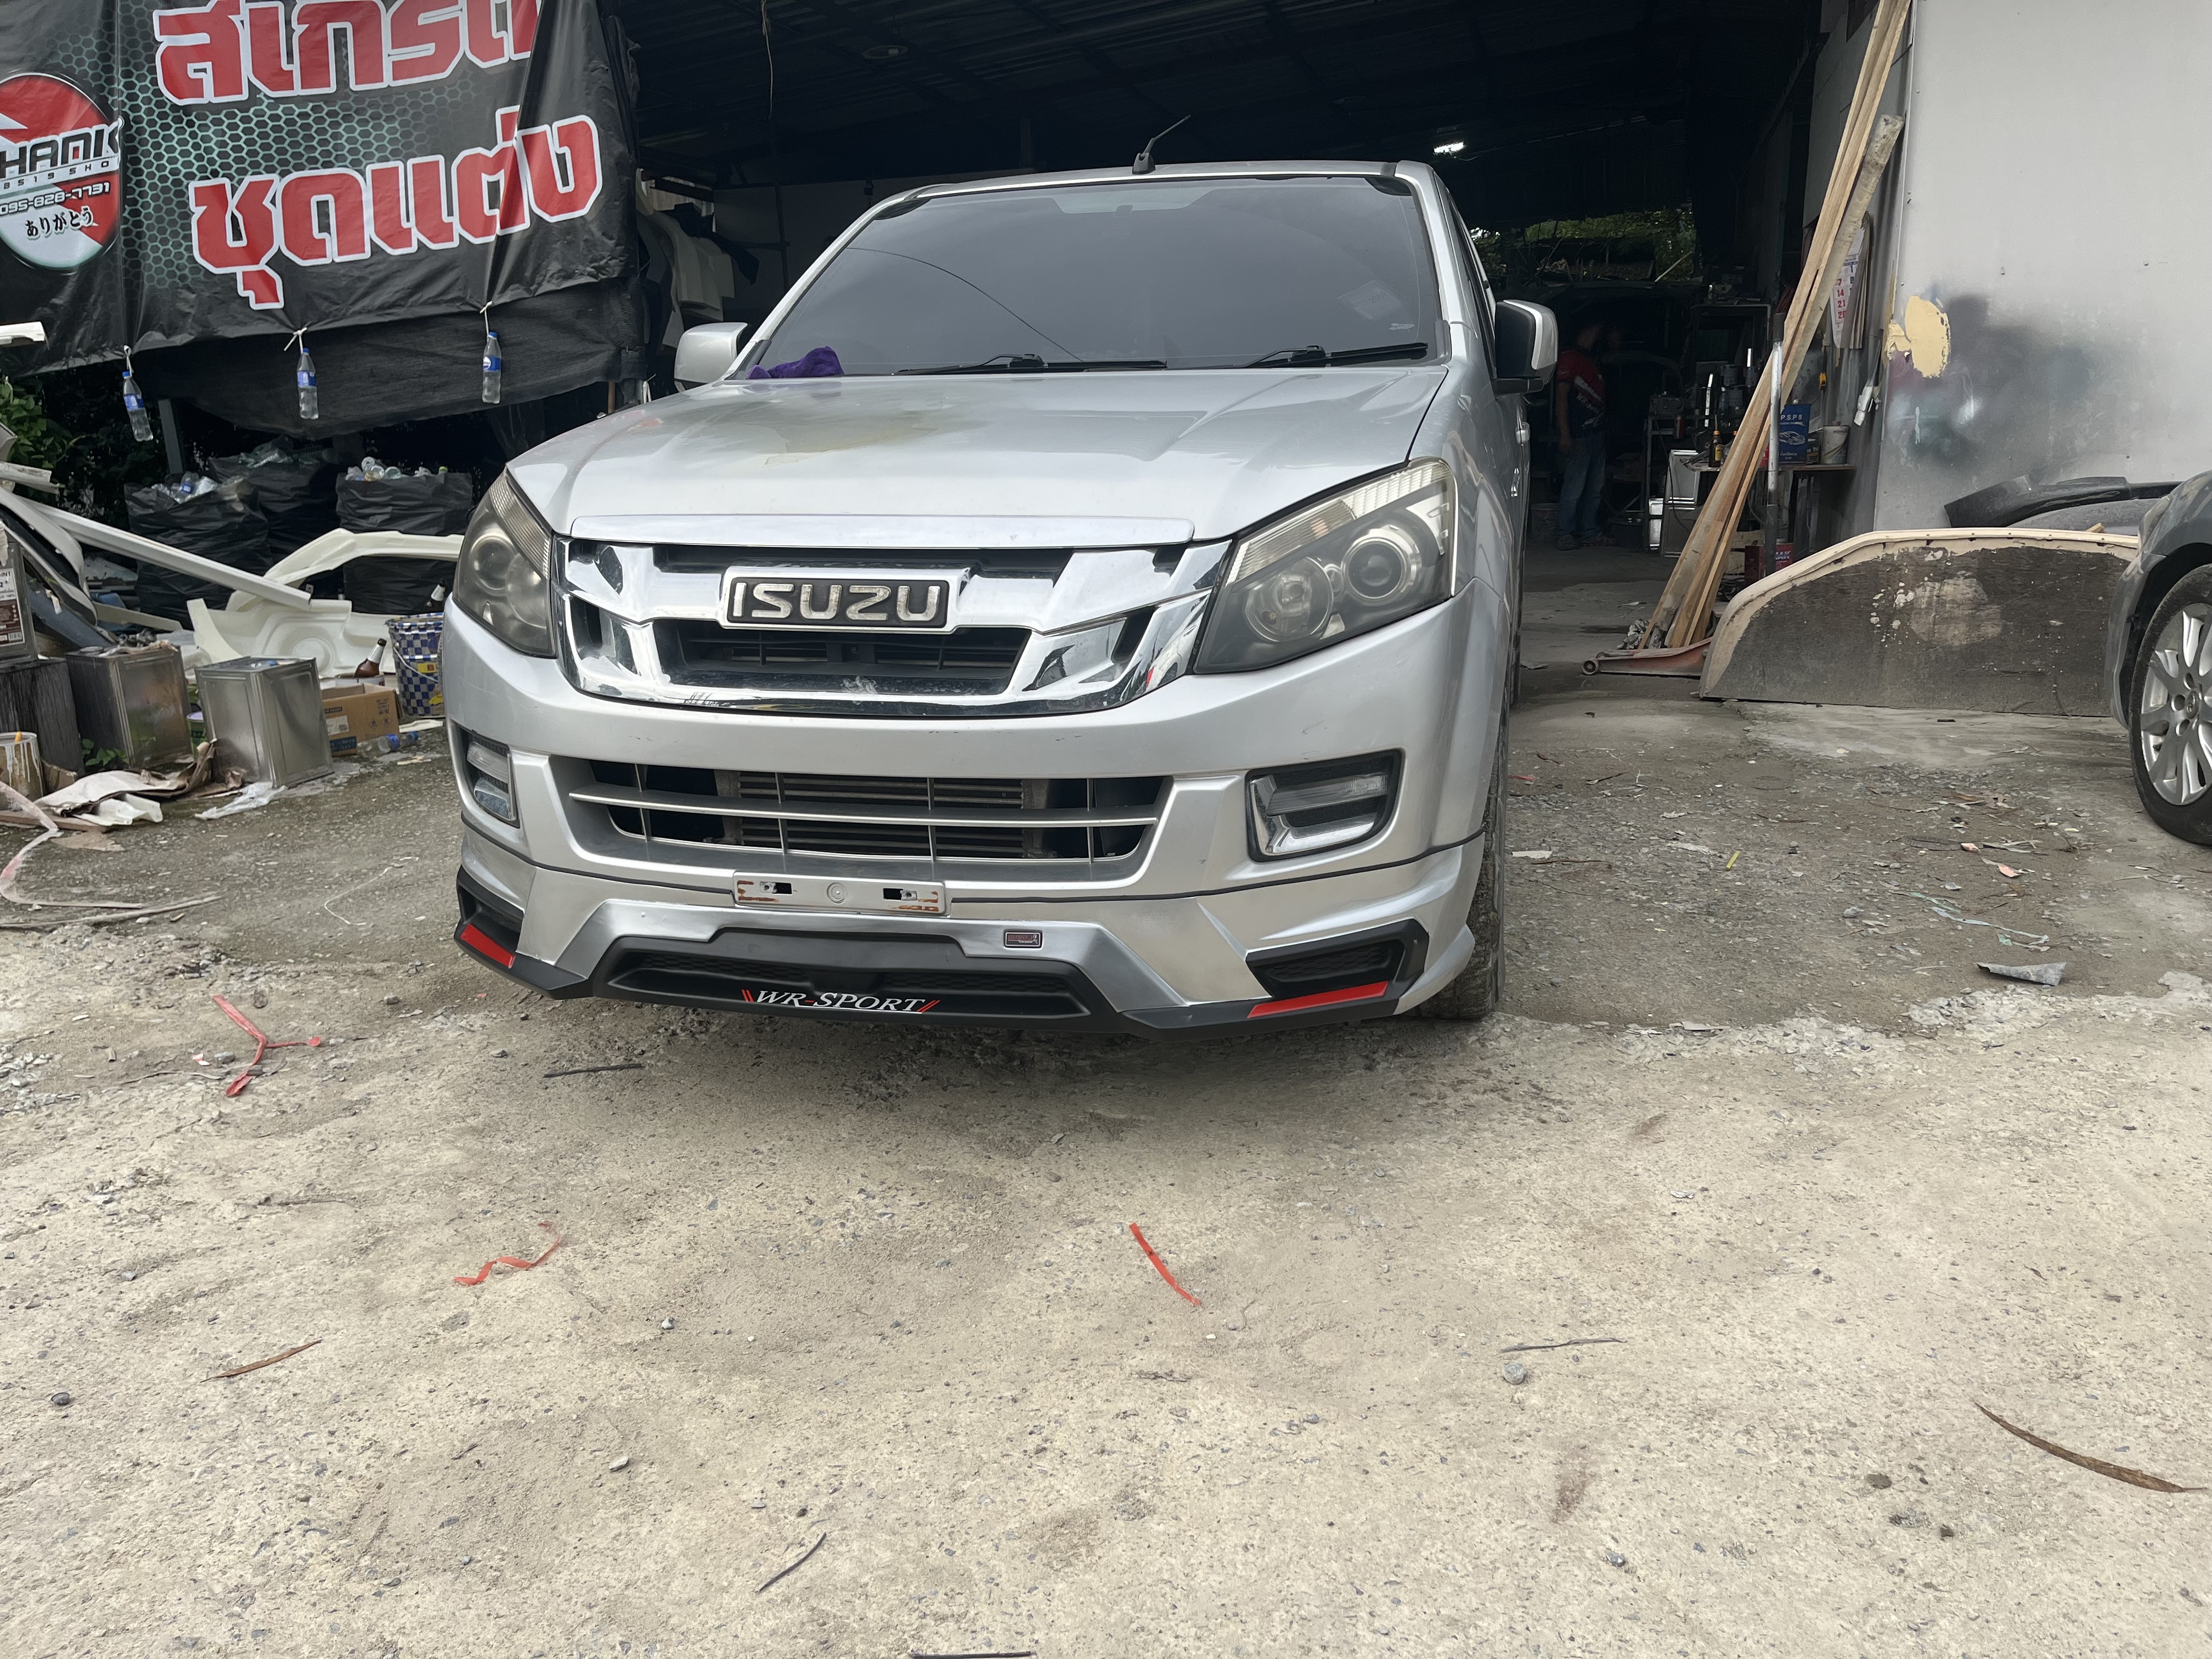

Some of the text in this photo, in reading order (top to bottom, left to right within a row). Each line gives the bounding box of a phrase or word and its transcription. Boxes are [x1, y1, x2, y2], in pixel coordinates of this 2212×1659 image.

[0, 182, 110, 214] 095-828-7731
[189, 105, 602, 309] ชุดแต่ง
[25, 207, 93, 236] ありがとう
[1837, 289, 1844, 297] 14
[1838, 300, 1846, 308] 21
[733, 582, 941, 621] ISUZU
[757, 990, 926, 1012] WR-SPORT
